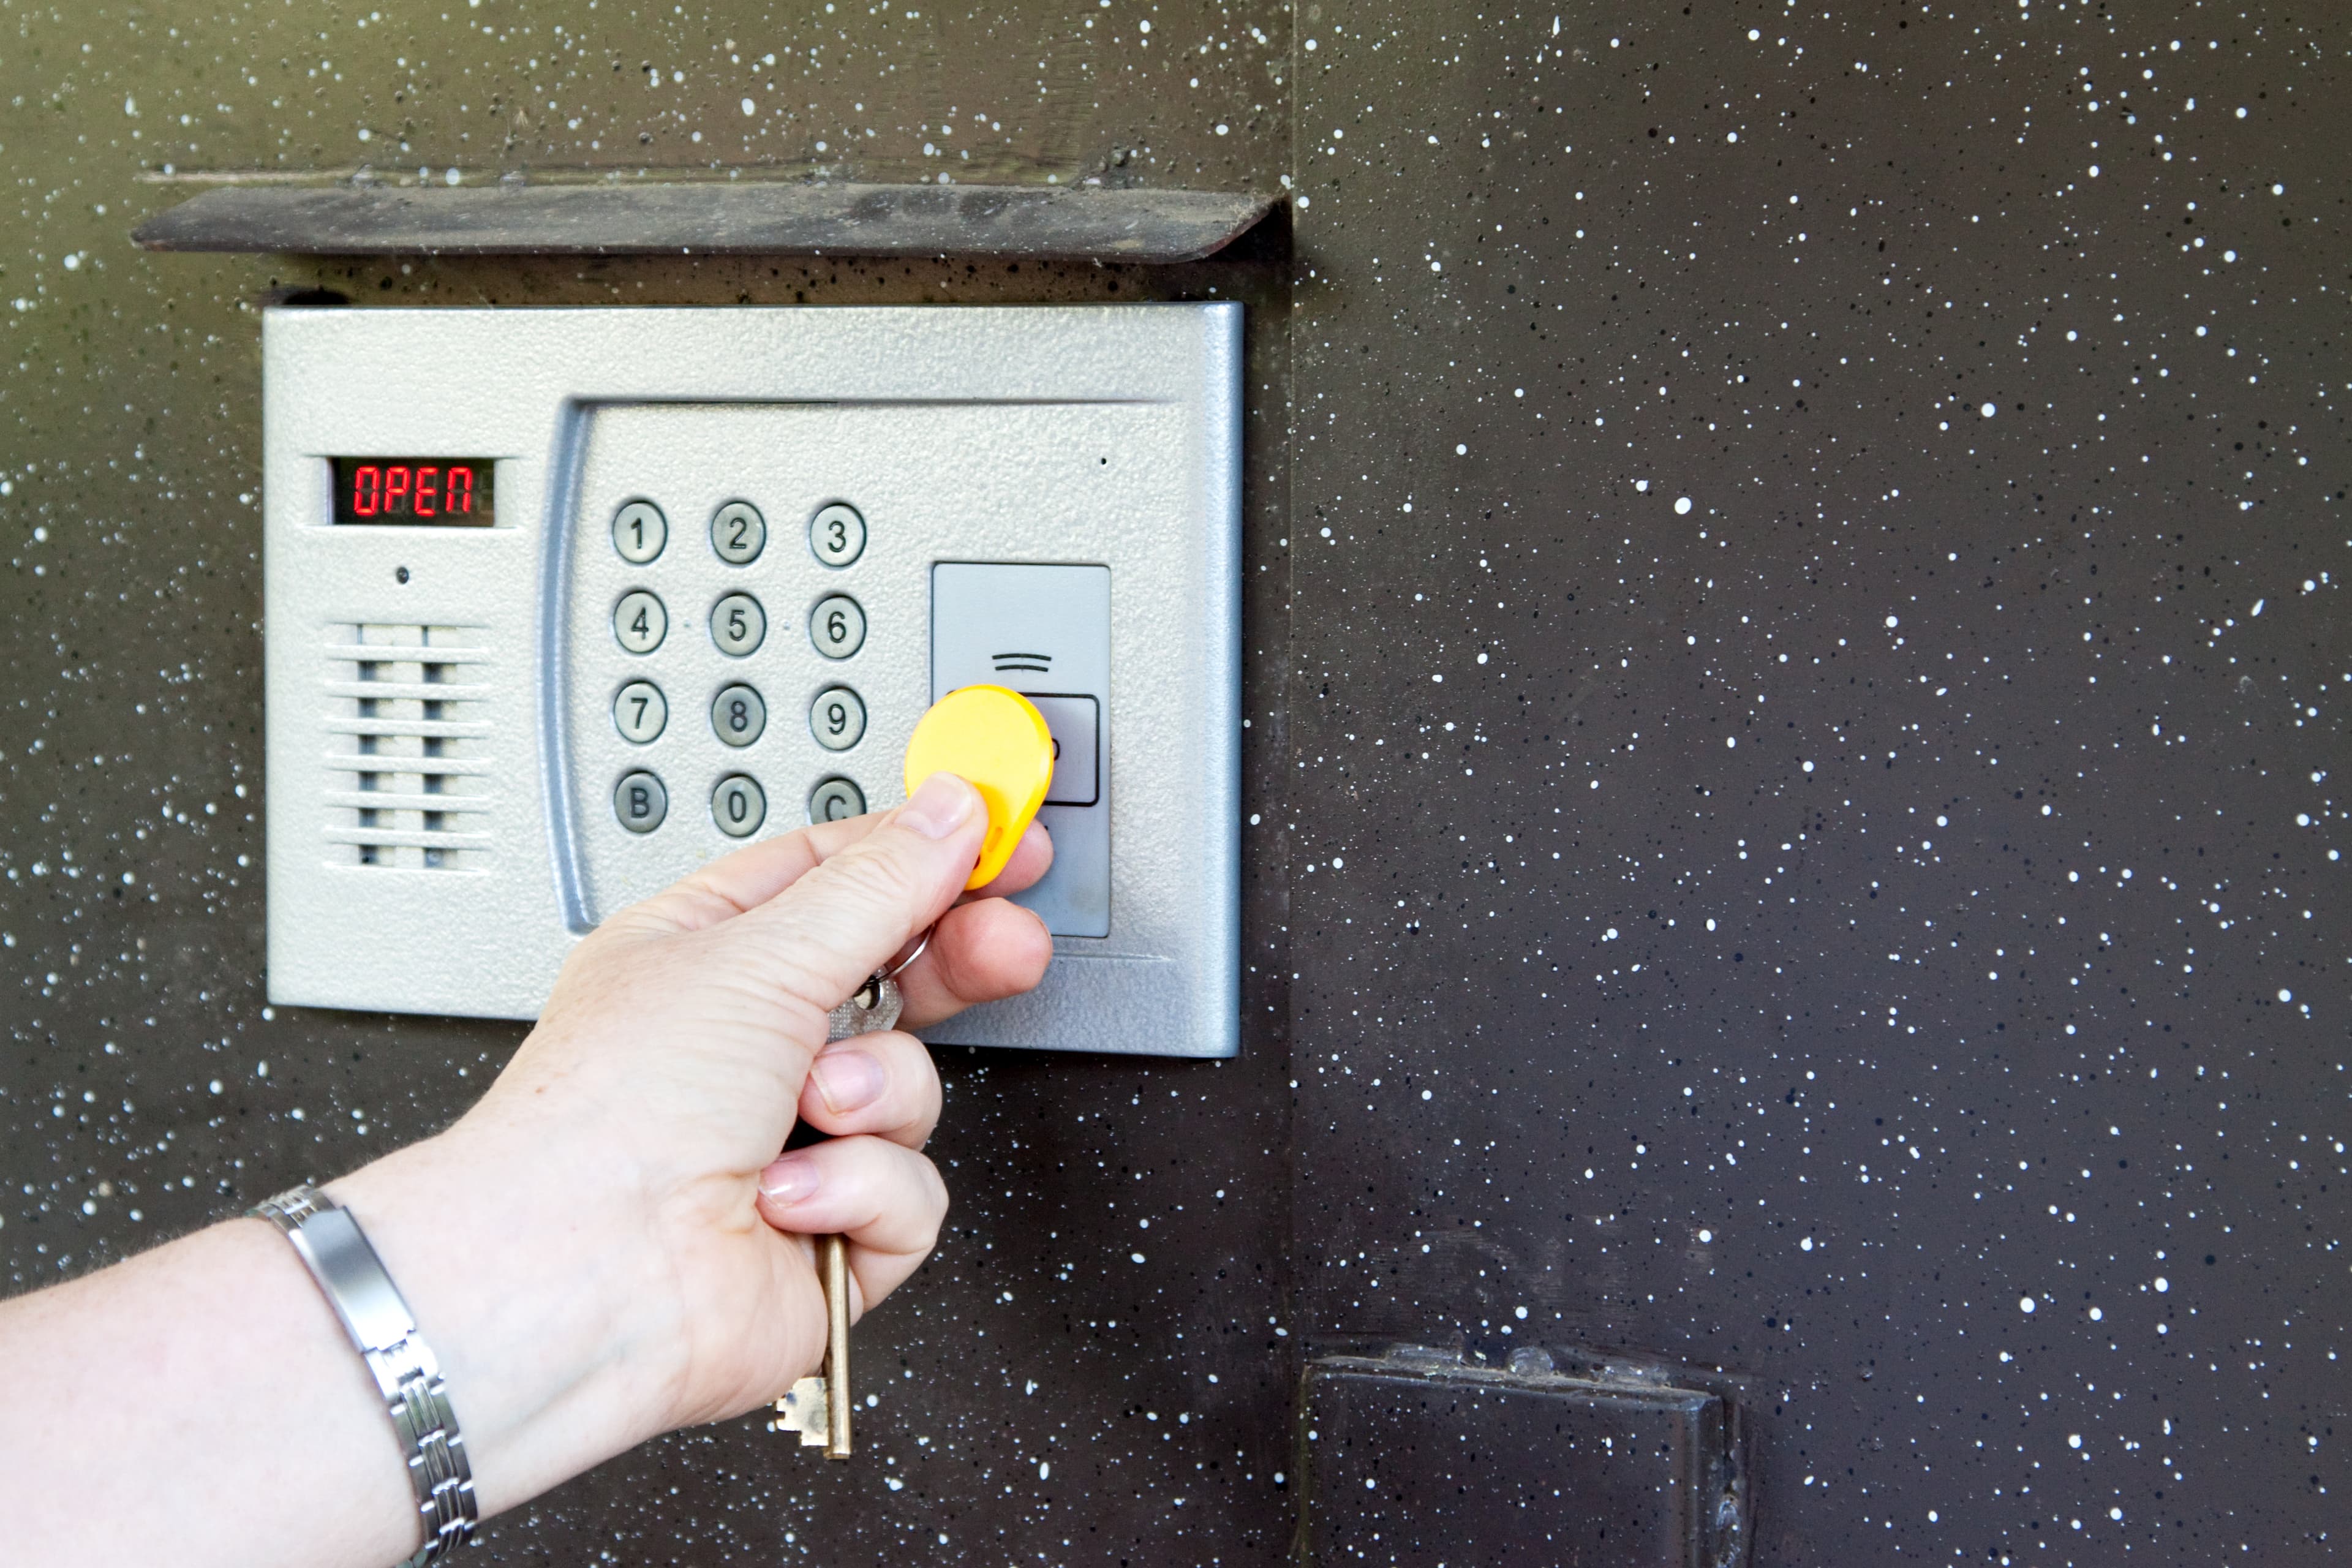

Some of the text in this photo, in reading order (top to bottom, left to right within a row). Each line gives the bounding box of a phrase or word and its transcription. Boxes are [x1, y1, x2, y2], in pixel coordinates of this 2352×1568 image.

[630, 517, 846, 552] 1 2 3
[631, 606, 846, 643] 4 5 6
[630, 697, 846, 736] 7 8 9
[630, 787, 847, 823] B 0 C
